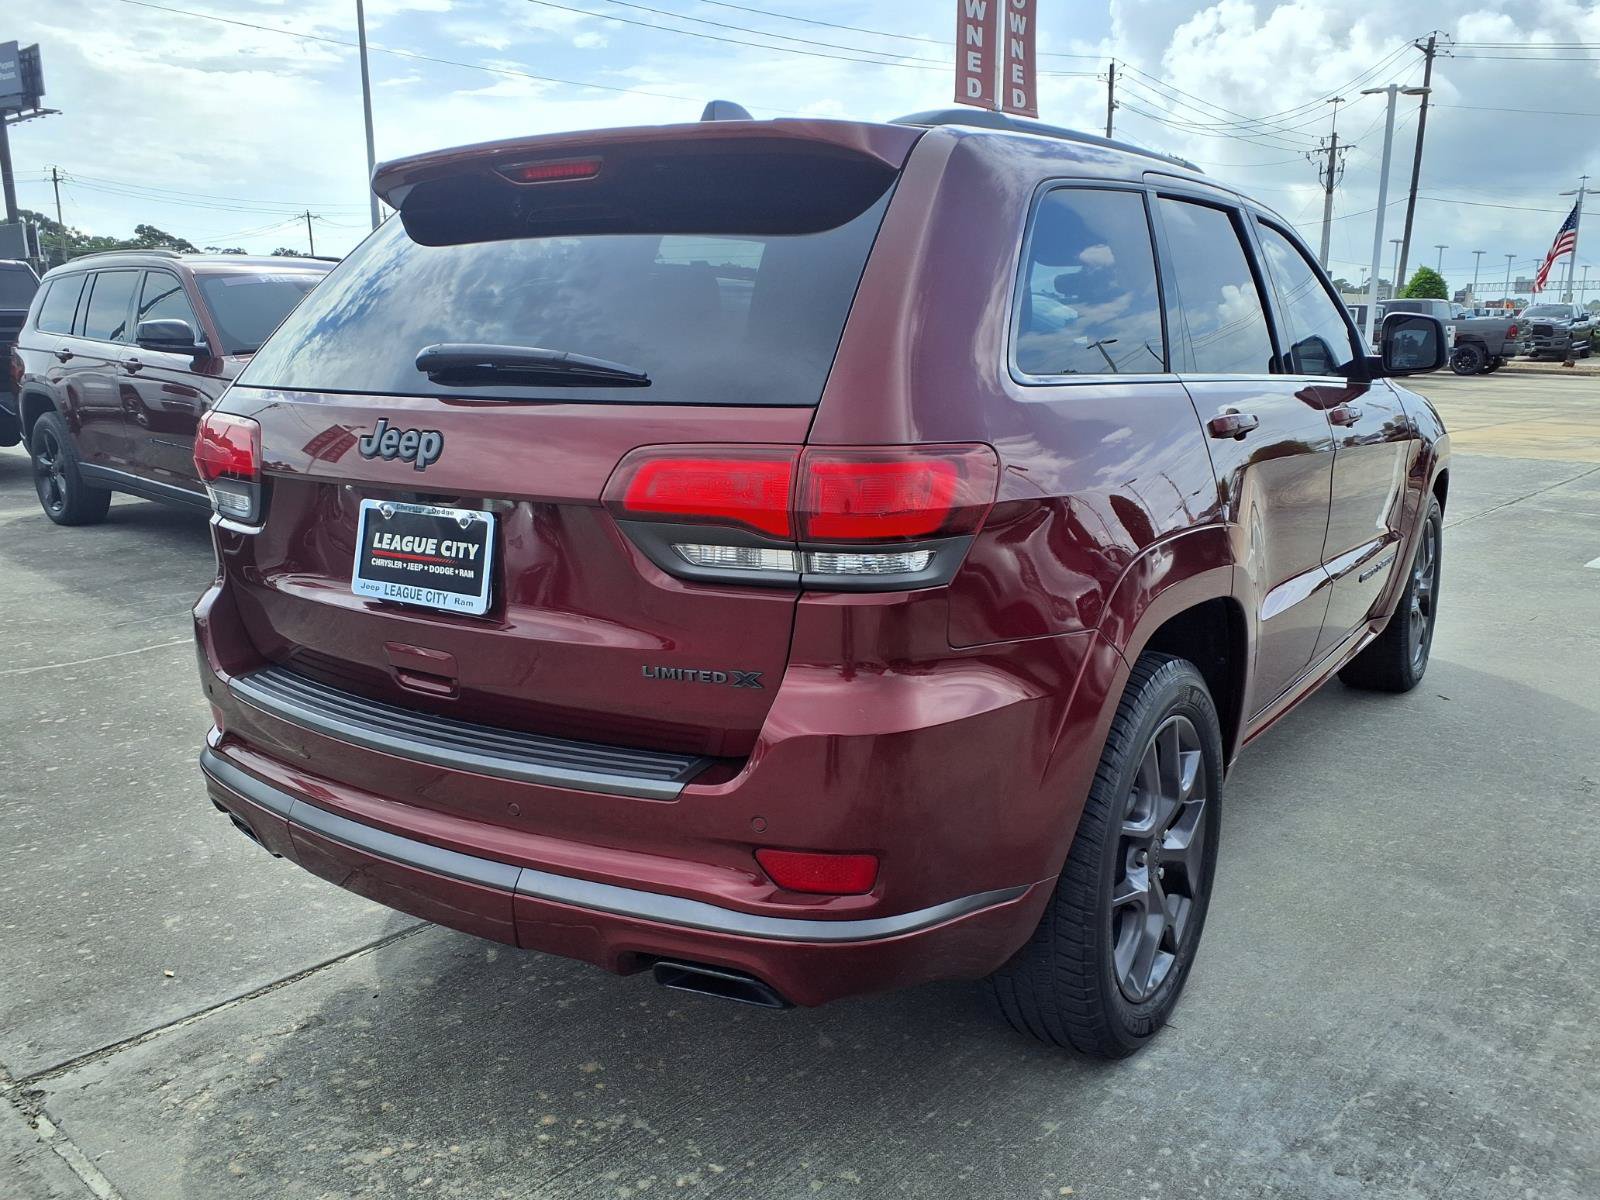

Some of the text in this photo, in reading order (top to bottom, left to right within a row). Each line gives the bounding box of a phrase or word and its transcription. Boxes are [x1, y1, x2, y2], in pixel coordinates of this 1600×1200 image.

[359, 417, 444, 471] Jeep
[373, 532, 479, 560] LEAGUE CITY
[371, 557, 474, 579] CHRYSLER JEEP DODGE RAM
[360, 582, 474, 607] Jeep LEAGUE CITY Ram
[642, 665, 764, 689] LIMITED X
